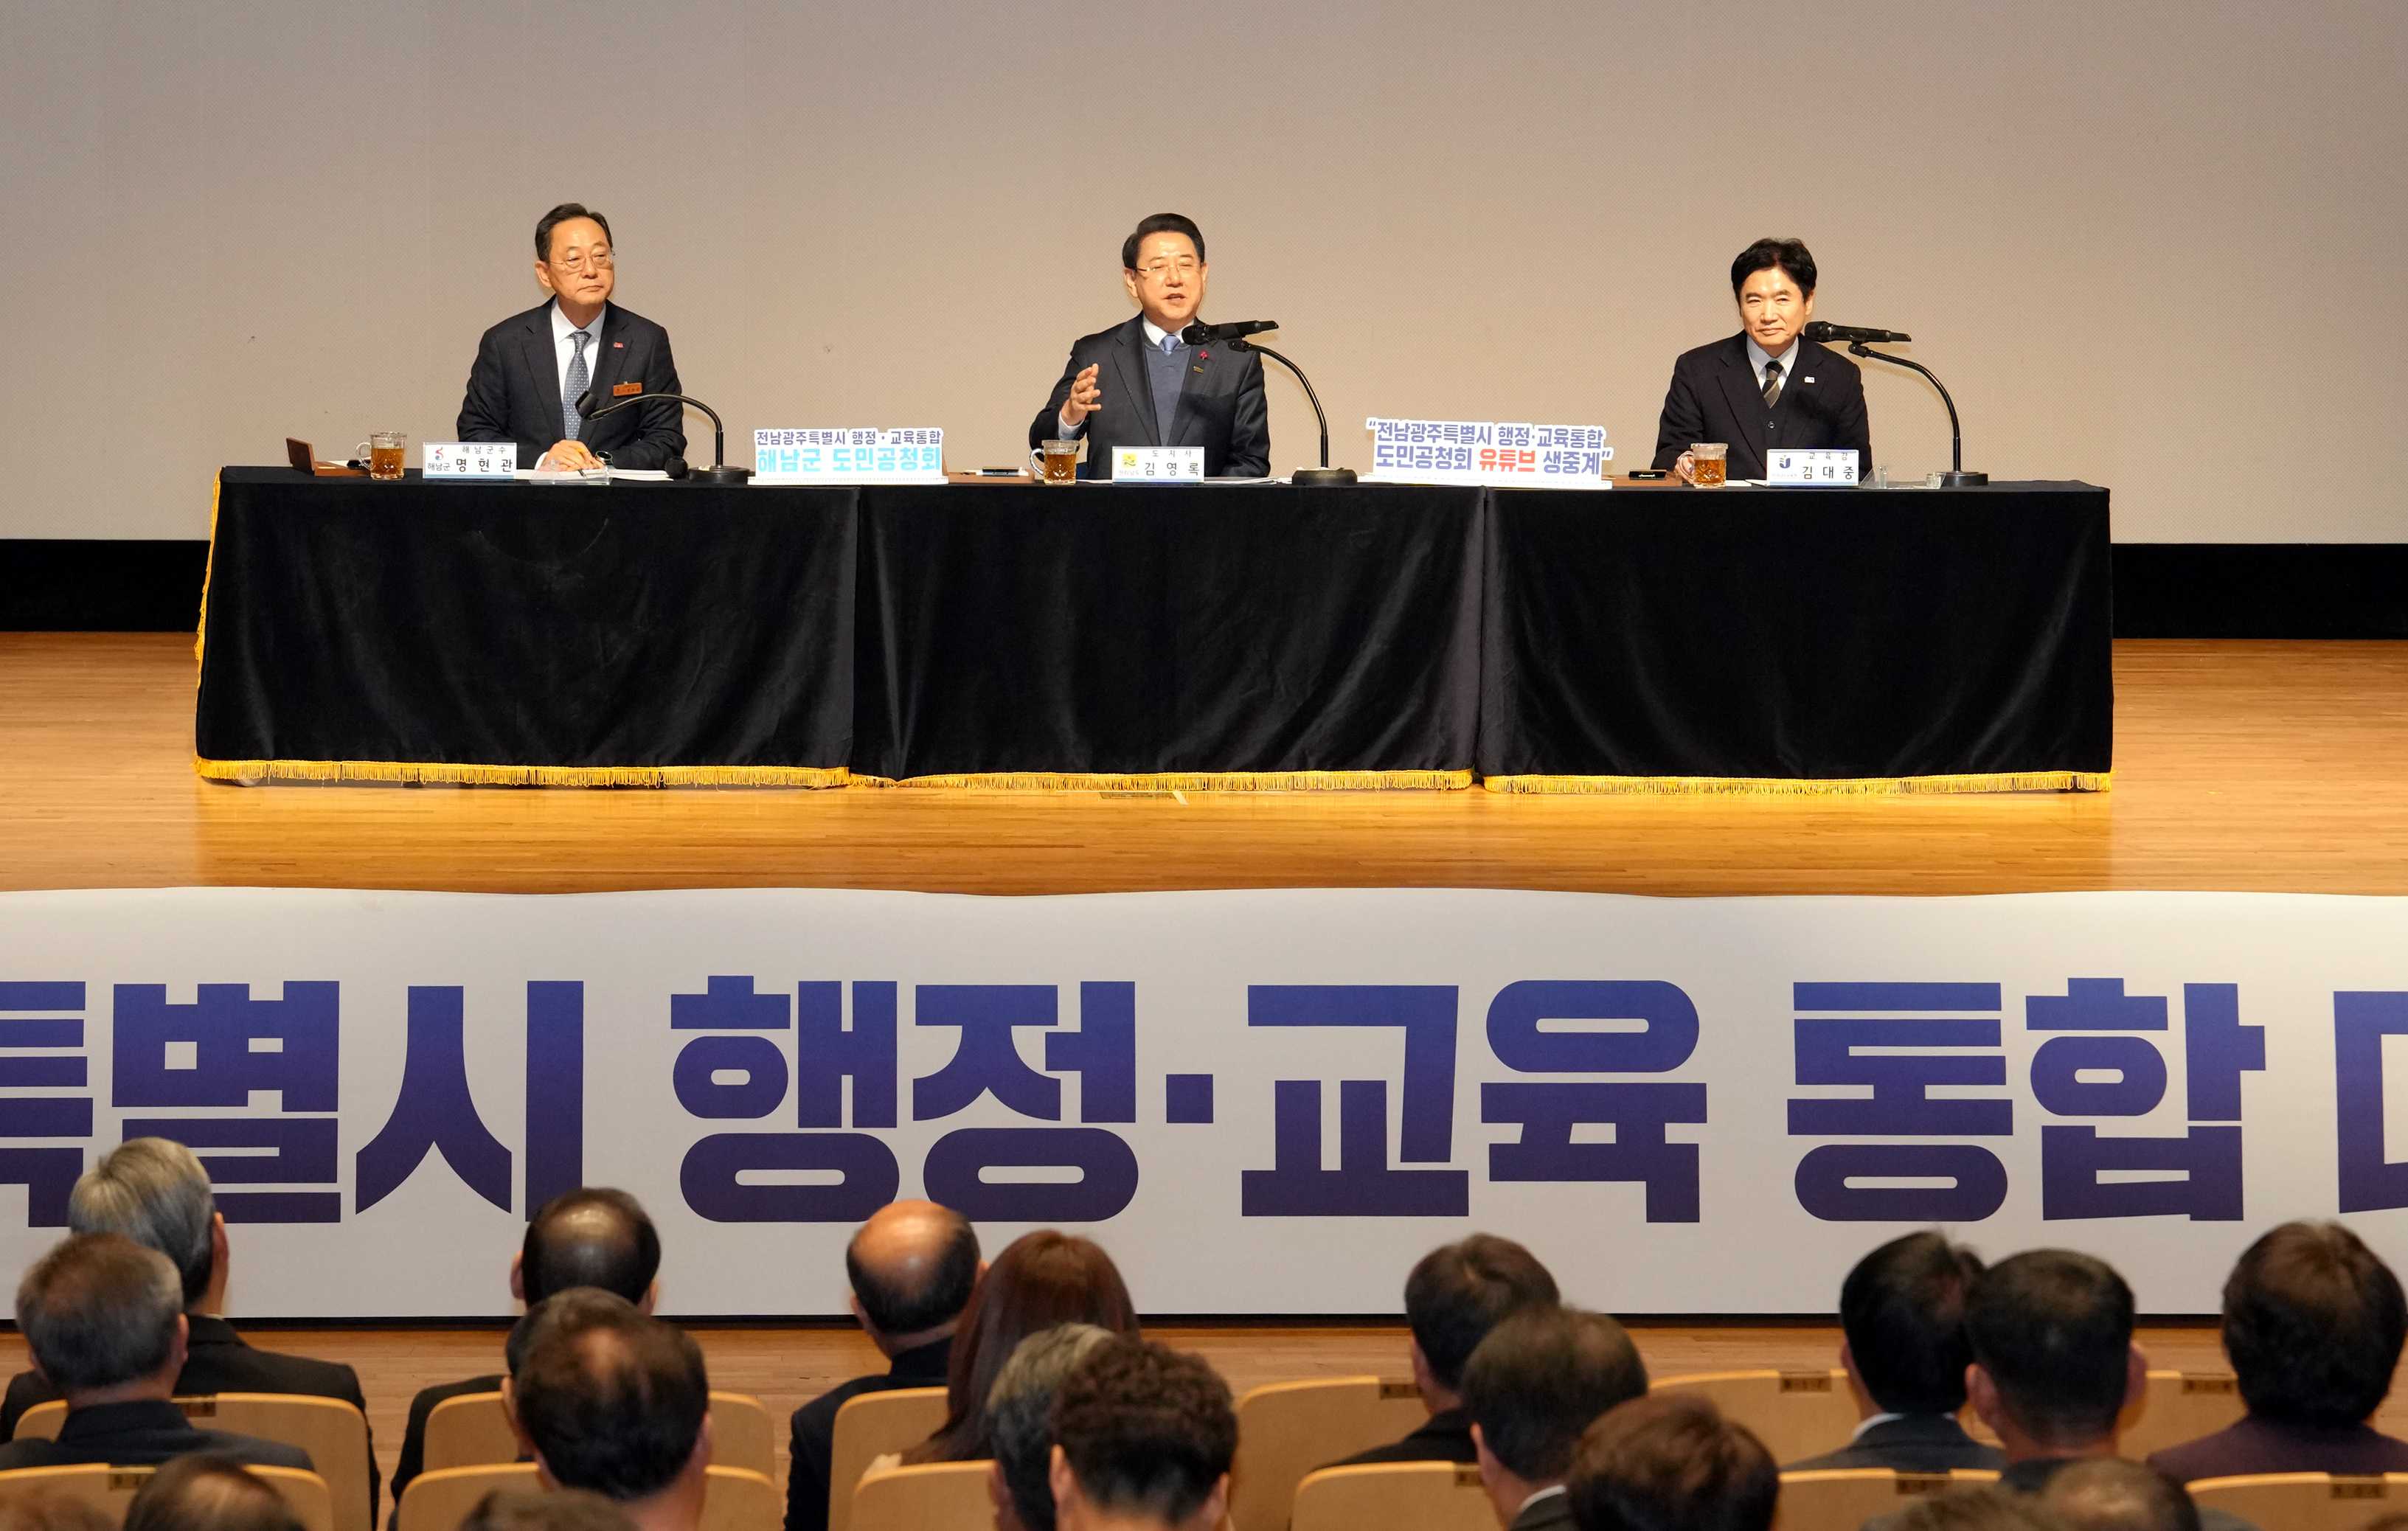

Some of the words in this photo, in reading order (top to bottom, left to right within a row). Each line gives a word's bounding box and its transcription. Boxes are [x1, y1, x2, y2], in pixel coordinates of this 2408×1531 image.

[756, 430, 847, 445] 전남광주특별시
[428, 462, 451, 471] 해남군
[757, 448, 822, 473] 해남군
[832, 446, 941, 472] 도민공청회
[1375, 445, 1473, 471] 도민공청회
[1478, 448, 1536, 473] 유튜브
[1787, 978, 2266, 1222] 통합
